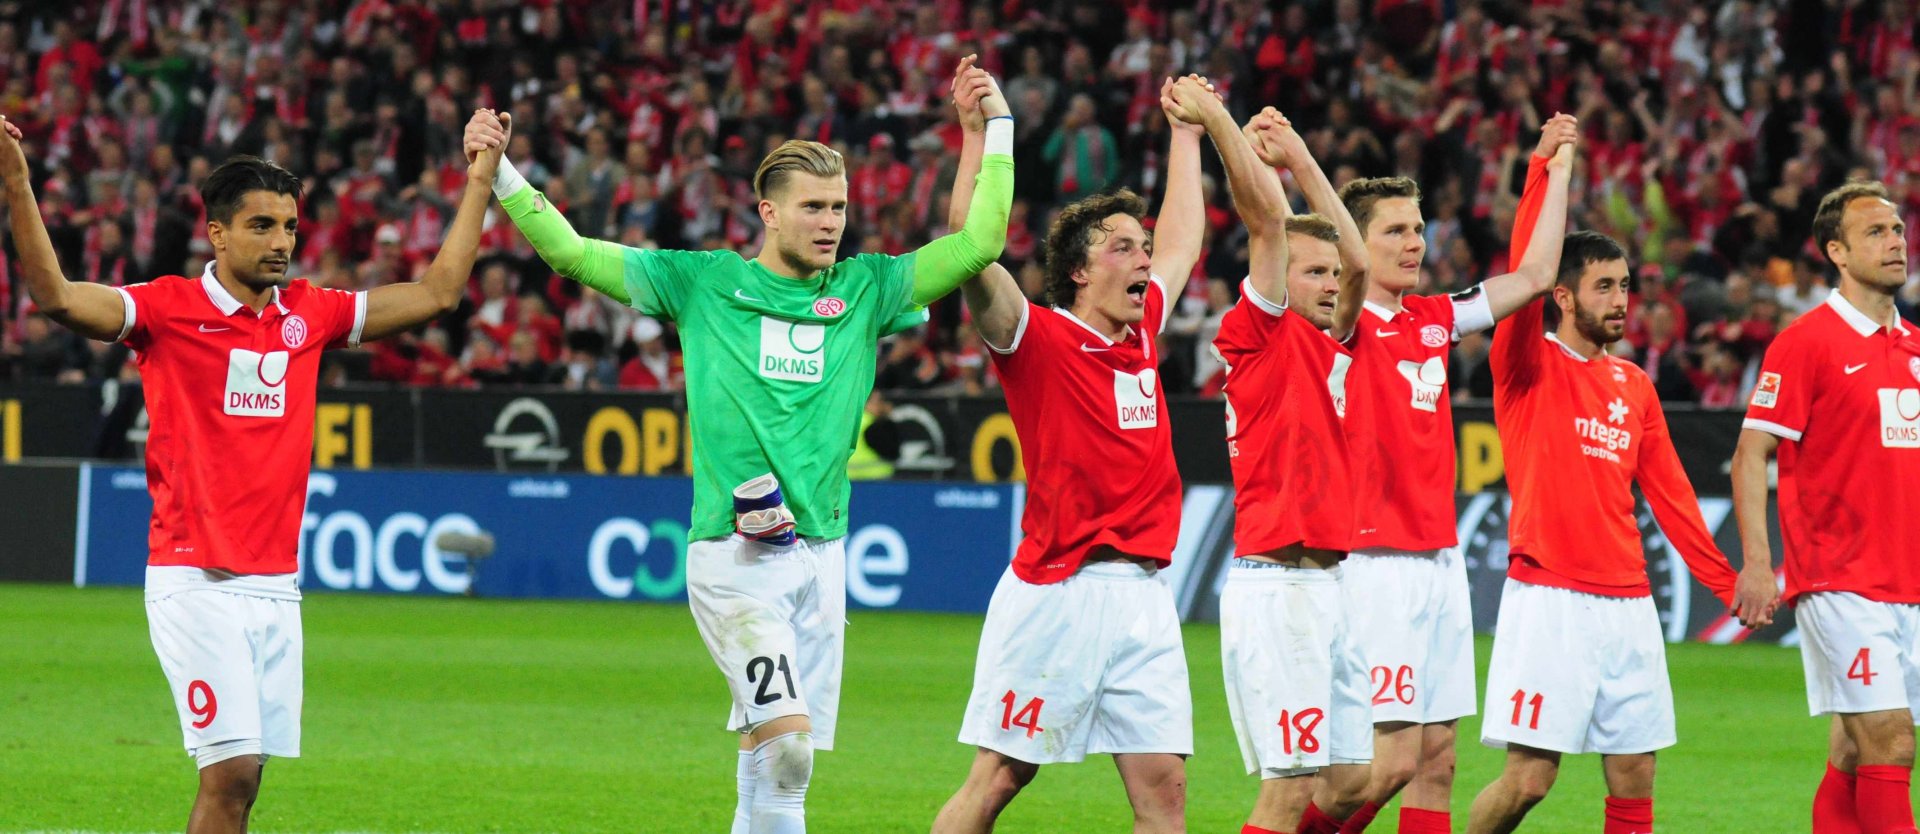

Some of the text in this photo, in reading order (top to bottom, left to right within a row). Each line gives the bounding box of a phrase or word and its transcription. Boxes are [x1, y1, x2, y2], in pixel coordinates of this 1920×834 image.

[765, 355, 819, 375] DKMS
[229, 392, 281, 410] DKMS
[1575, 417, 1631, 450] ntega
[1886, 426, 1918, 441] DKMS
[297, 472, 482, 593] face
[746, 653, 797, 706] 21
[1370, 664, 1416, 706] 26
[1847, 647, 1878, 686] 4
[188, 679, 217, 730] 9
[1001, 689, 1044, 740] 14
[1510, 688, 1544, 731] 11
[1277, 707, 1325, 755] 18
